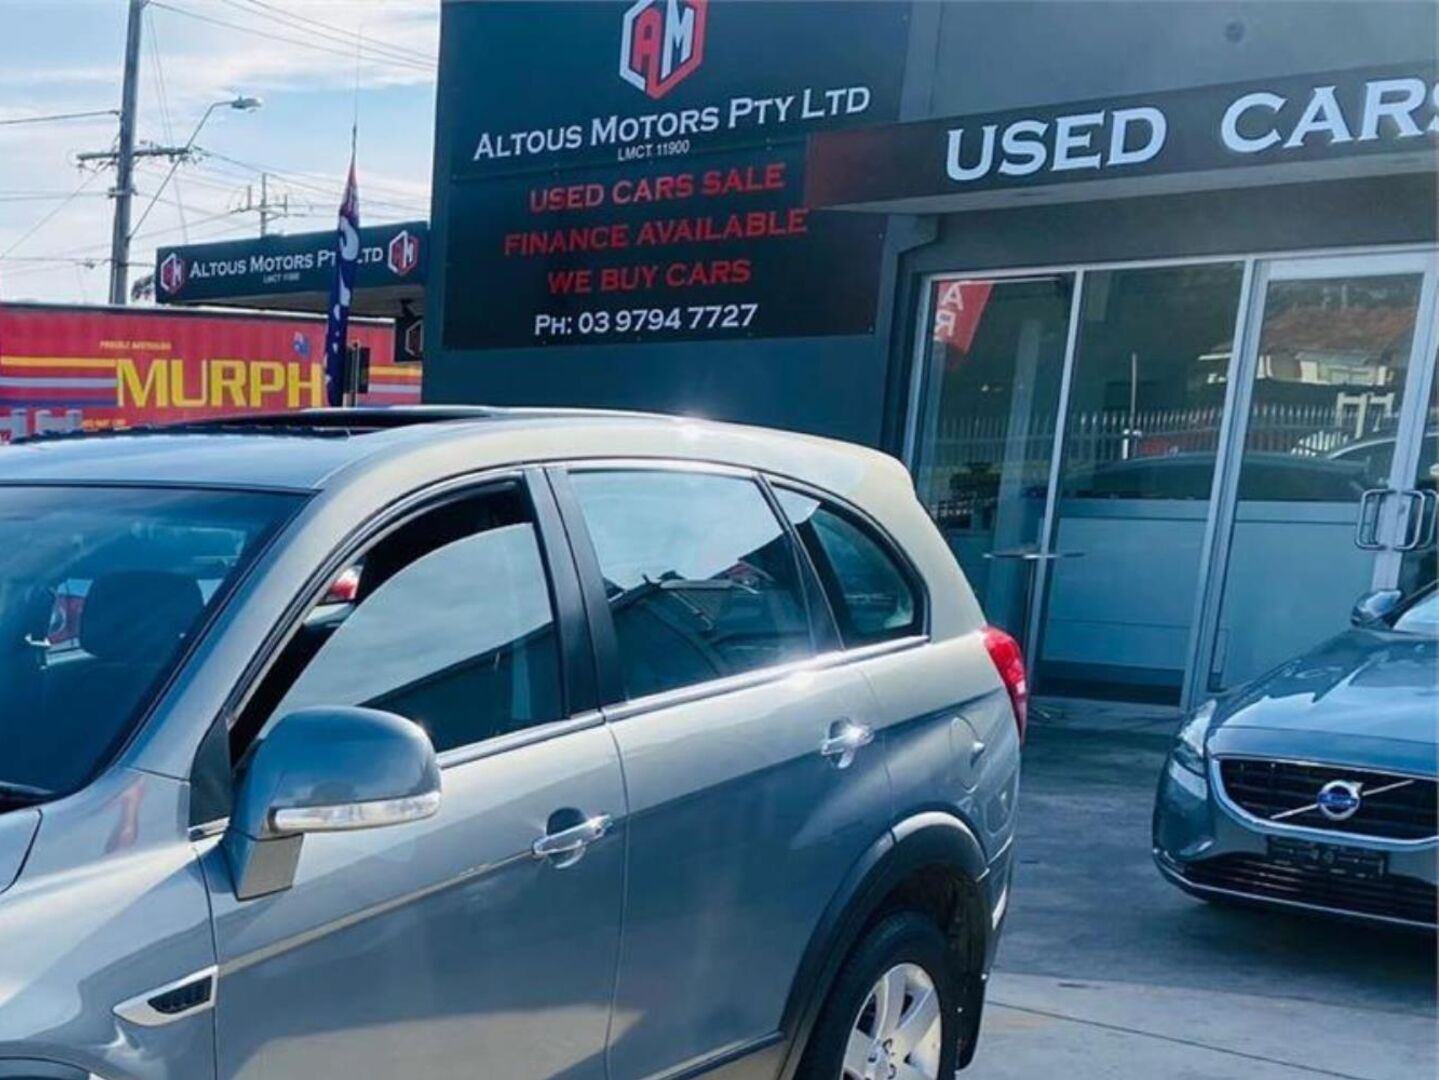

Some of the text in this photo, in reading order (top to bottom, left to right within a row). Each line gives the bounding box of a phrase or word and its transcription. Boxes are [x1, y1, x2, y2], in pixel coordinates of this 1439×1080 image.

[473, 86, 871, 161] ALTOUS MOTORS PTY LTD
[946, 77, 1439, 181] USED CAR
[617, 139, 690, 161] LMCT 11900
[530, 162, 786, 213] USED CARS SALE
[504, 208, 809, 256] FINANCE AVAILABLE
[190, 247, 384, 279] ALTOUS MOTORS PT TD
[548, 260, 753, 294] WE BUY CARS
[578, 311, 610, 334] 03
[615, 308, 682, 332] 9794
[687, 304, 759, 330] 7727
[117, 358, 326, 408] MURPH
